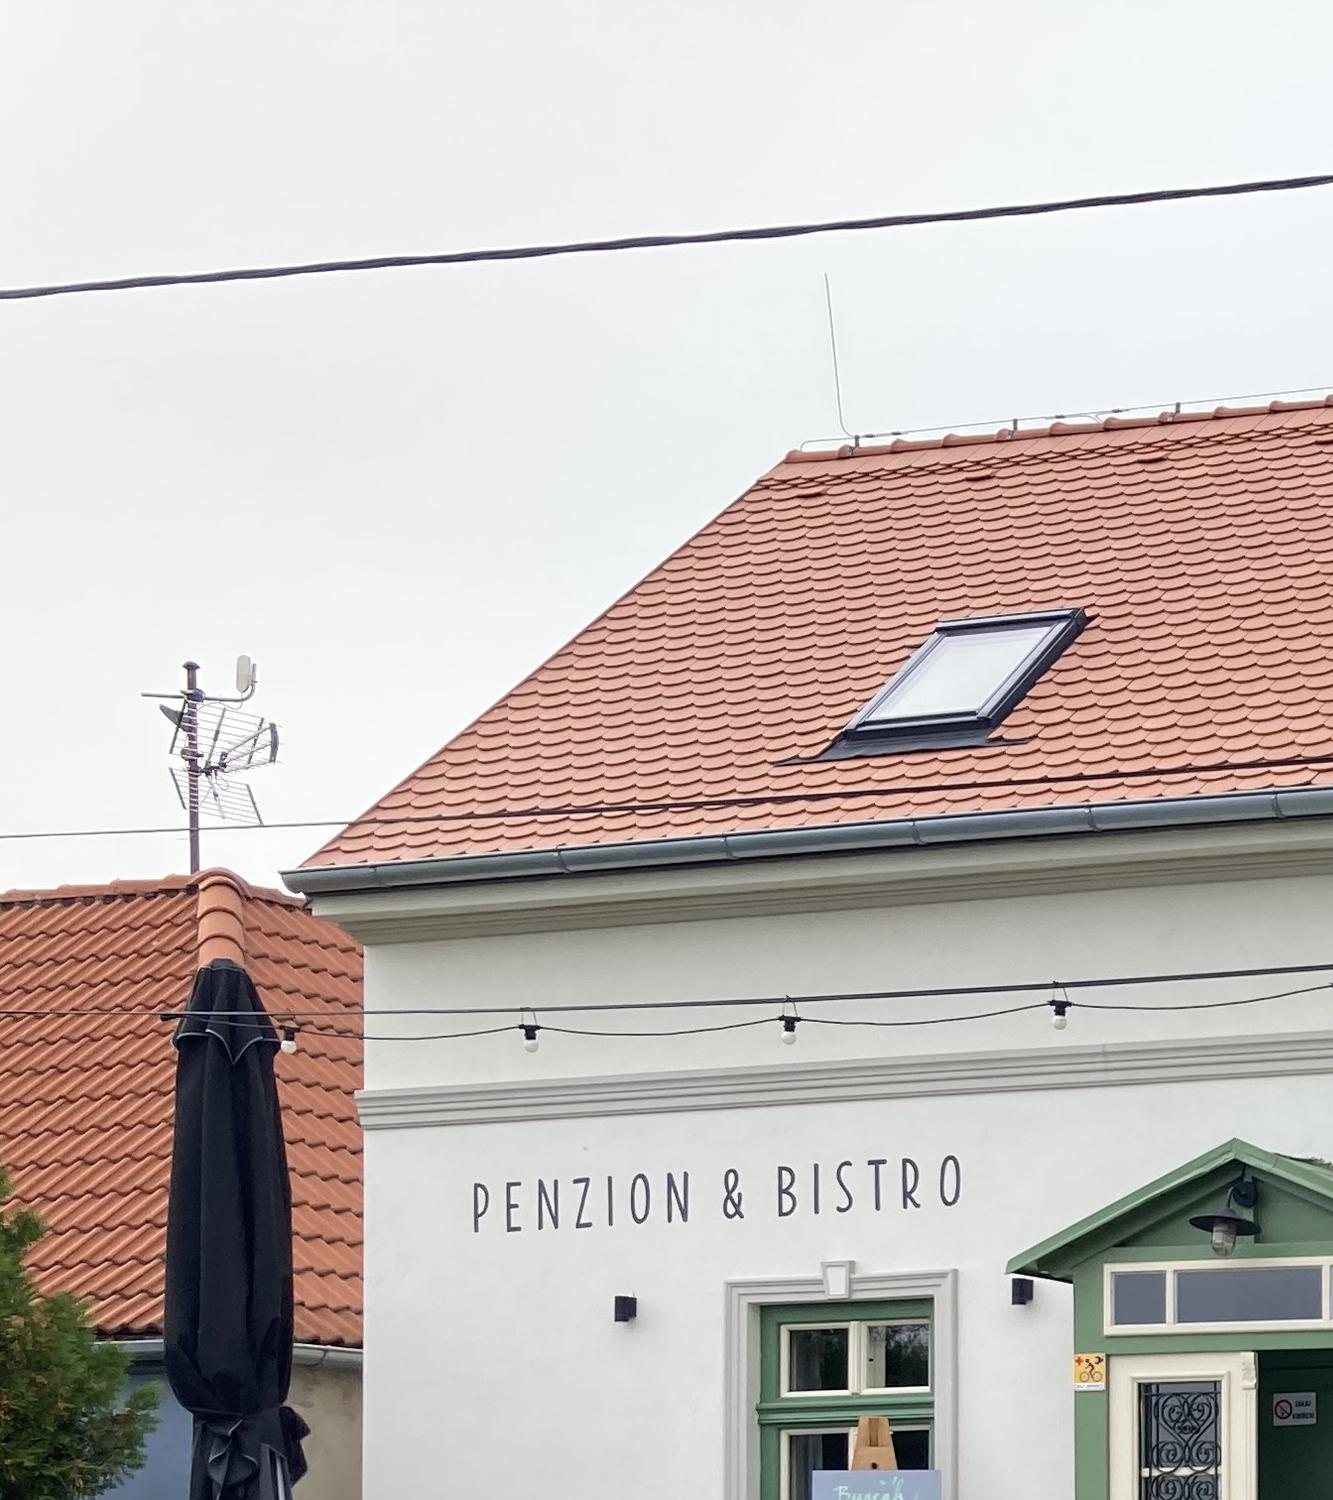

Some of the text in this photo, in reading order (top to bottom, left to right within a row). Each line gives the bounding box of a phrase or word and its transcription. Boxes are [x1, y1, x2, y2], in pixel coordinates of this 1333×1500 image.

[473, 1154, 962, 1233] PENZION & BISTRO
